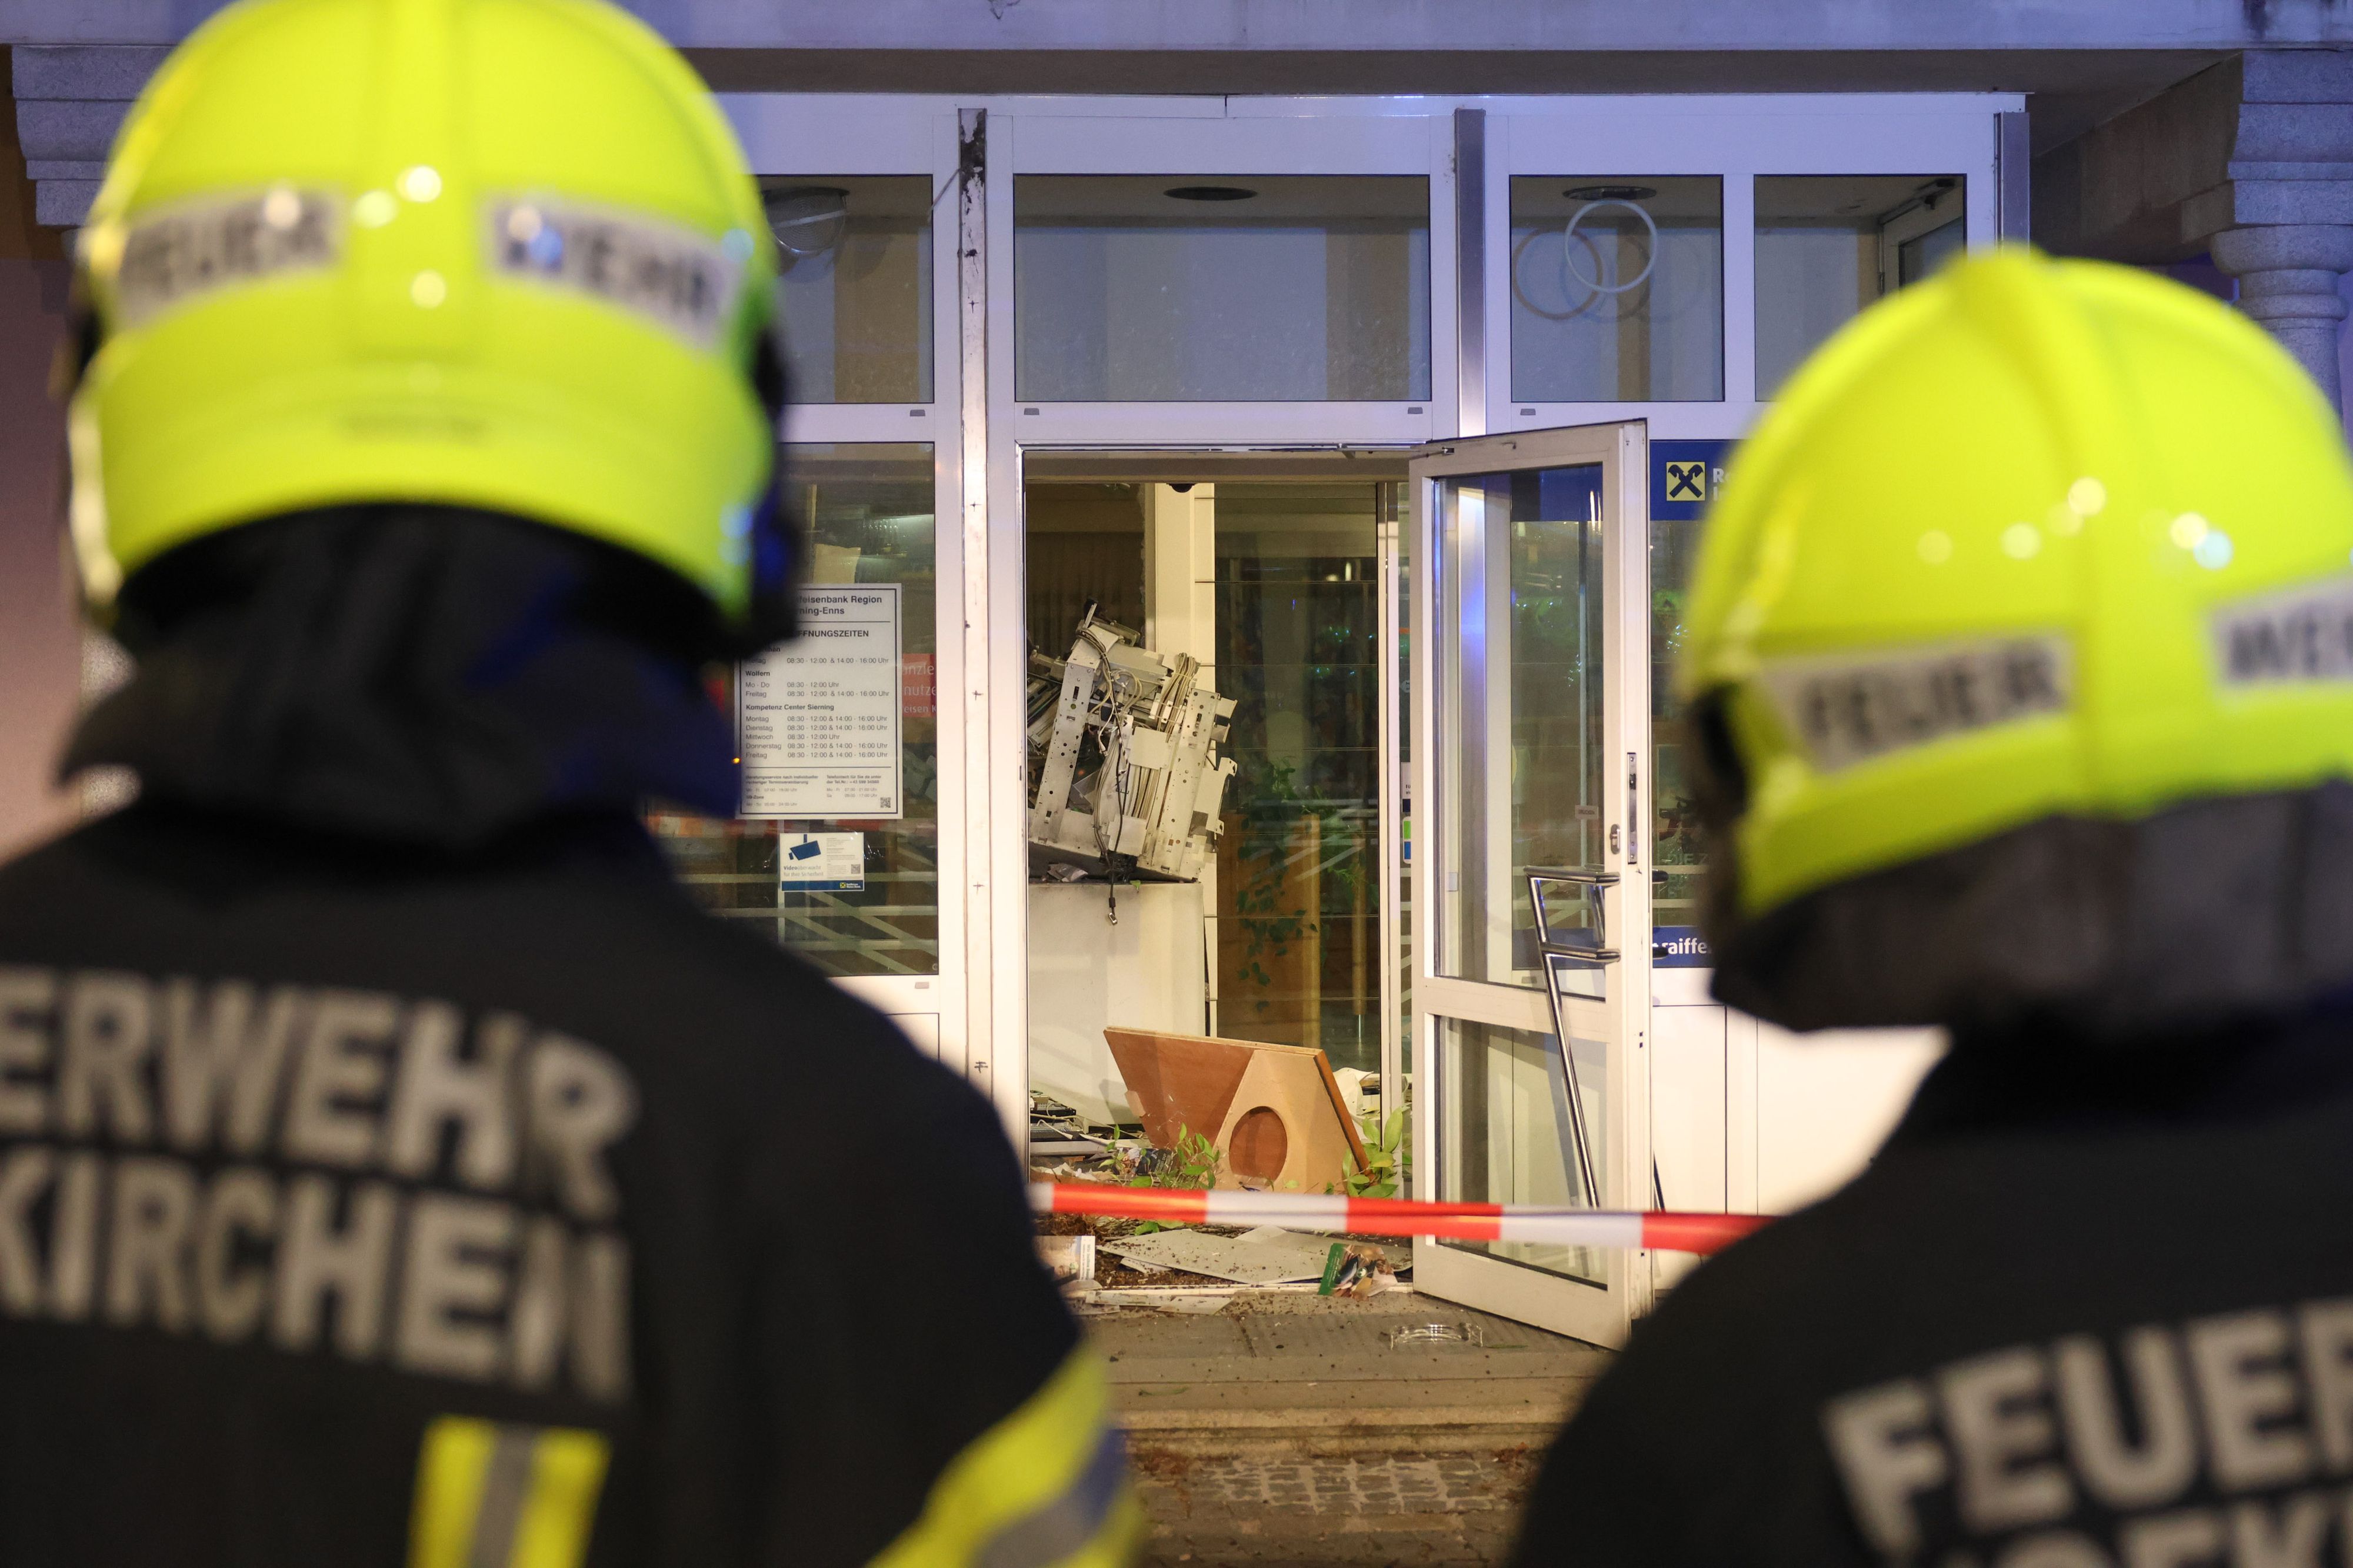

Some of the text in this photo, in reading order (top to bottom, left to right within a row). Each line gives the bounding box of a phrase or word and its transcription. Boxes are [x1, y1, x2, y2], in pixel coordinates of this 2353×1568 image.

[851, 595, 882, 605] Region
[799, 606, 845, 616] ning-Enns
[798, 629, 869, 638] FFNUNGSZEITEN
[745, 690, 767, 699] Freitag
[1662, 937, 1712, 955] raiffe
